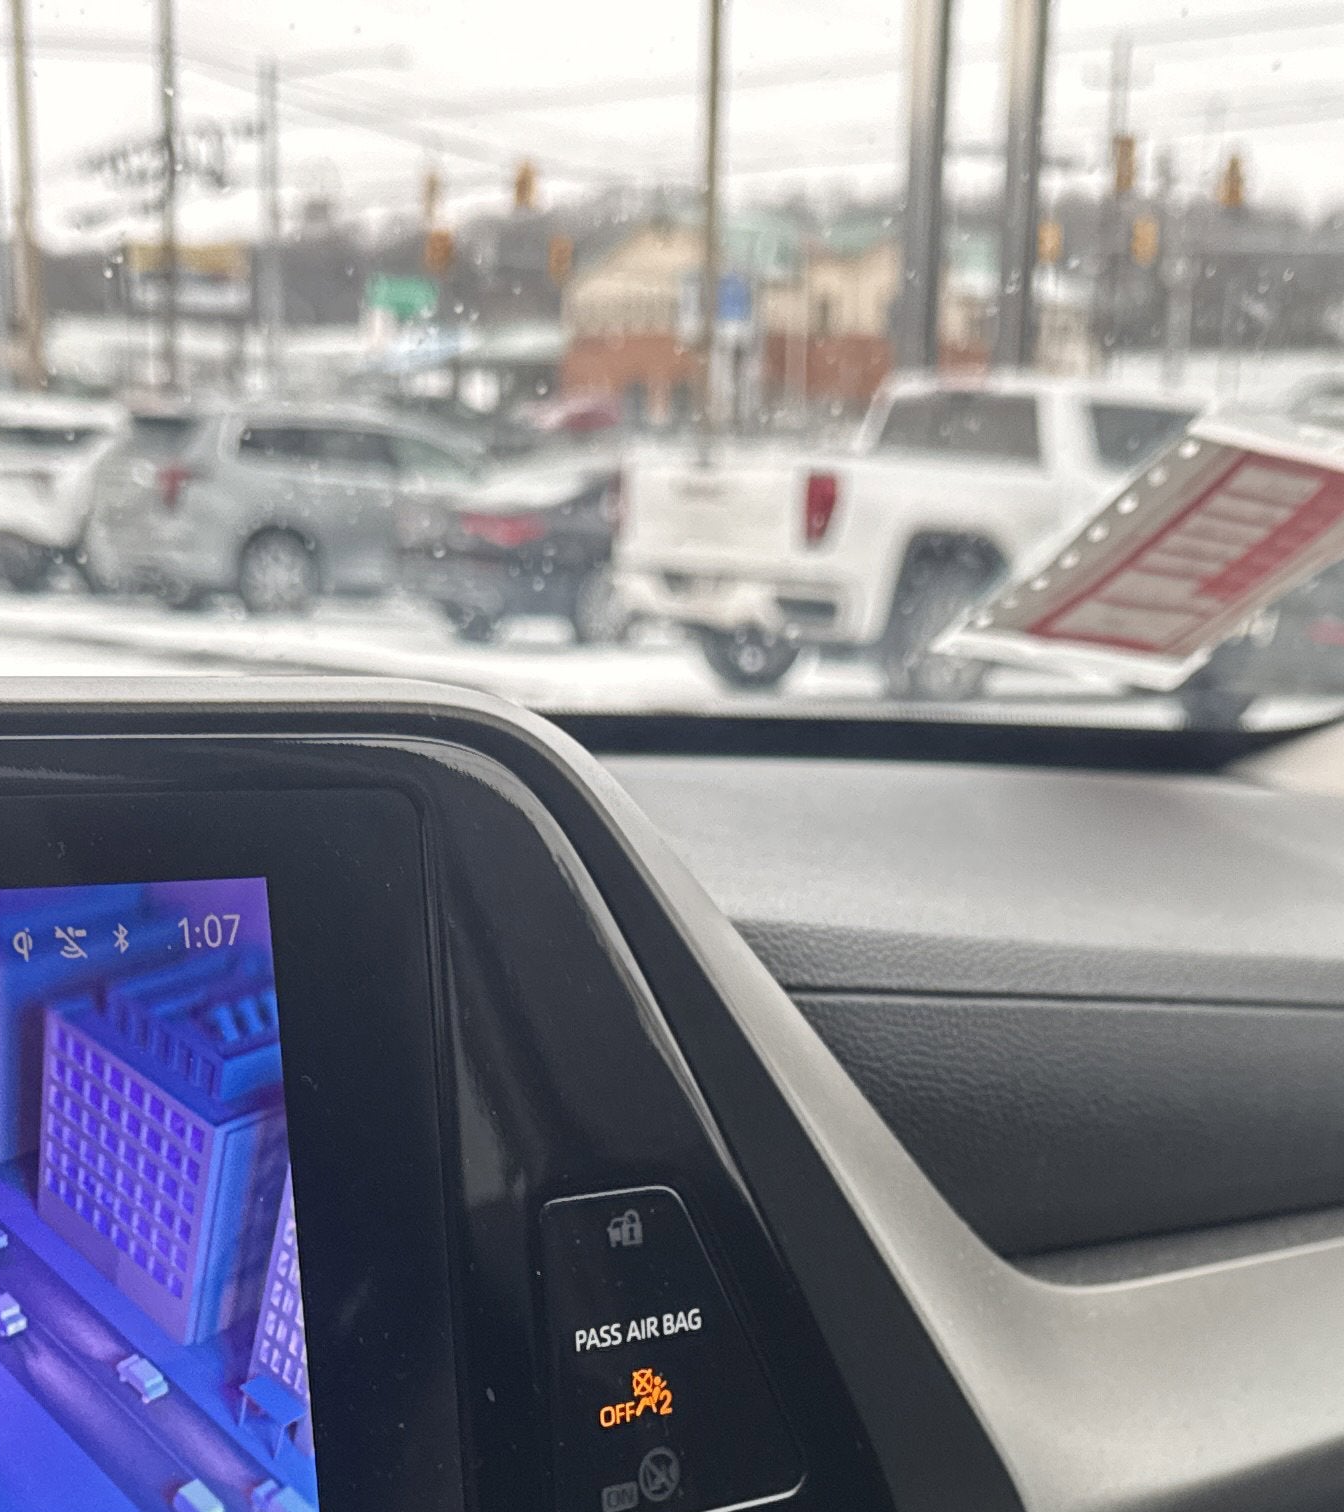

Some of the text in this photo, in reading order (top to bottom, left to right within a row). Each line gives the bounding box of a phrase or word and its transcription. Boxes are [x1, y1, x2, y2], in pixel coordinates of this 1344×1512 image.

[177, 913, 241, 949] 1:07
[574, 1307, 703, 1352] PASS AIR BAG
[599, 1401, 636, 1428] OFF
